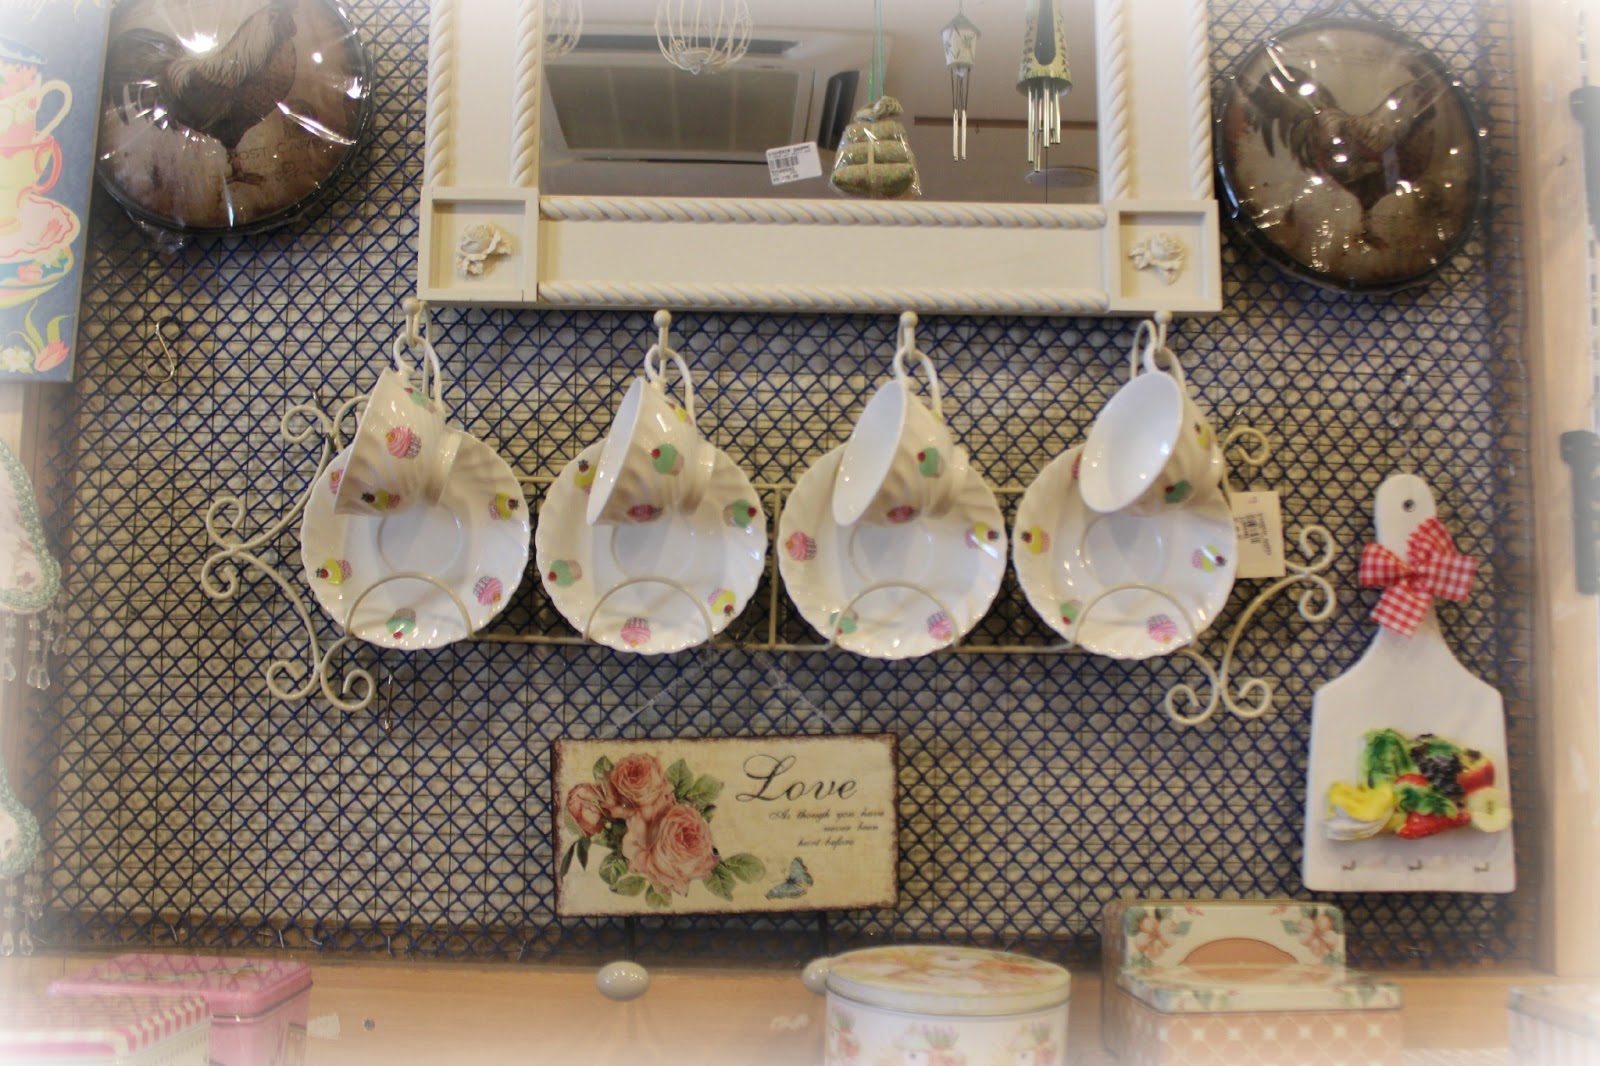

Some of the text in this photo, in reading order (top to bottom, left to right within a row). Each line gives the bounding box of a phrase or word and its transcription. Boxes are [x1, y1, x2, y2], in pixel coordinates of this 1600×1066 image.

[736, 755, 858, 802] Love
[797, 809, 830, 821] though
[836, 812, 854, 821] you
[861, 807, 885, 817] have
[825, 837, 854, 850] before
